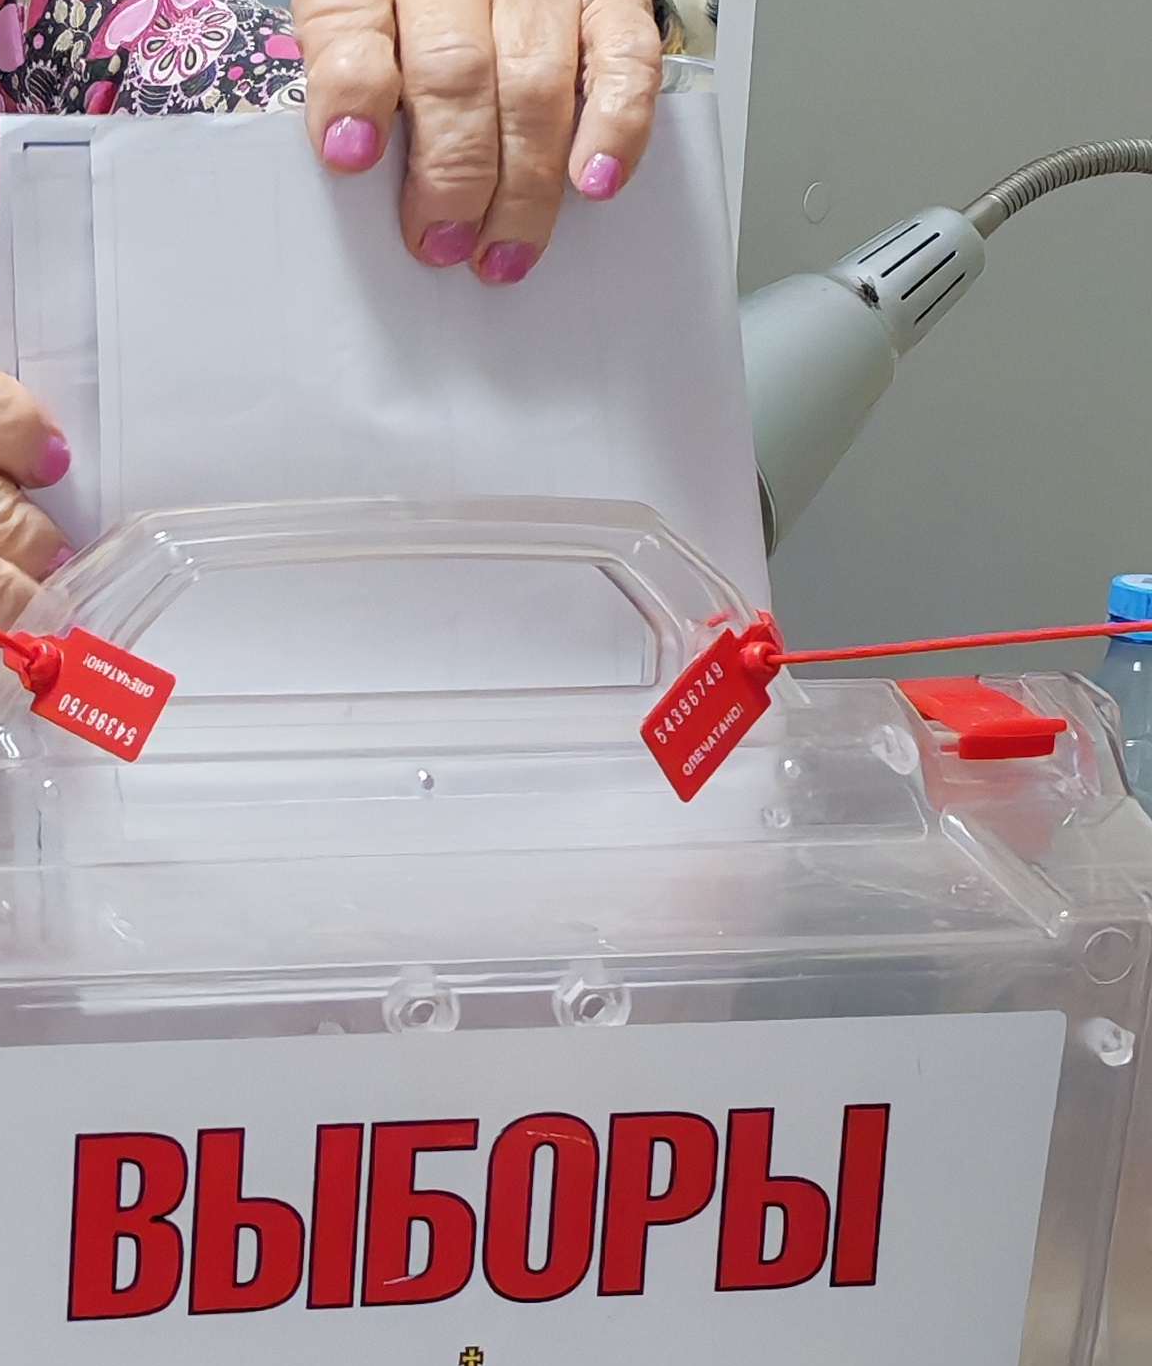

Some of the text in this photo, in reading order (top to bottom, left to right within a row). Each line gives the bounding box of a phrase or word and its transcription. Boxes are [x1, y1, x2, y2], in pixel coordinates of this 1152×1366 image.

[82, 652, 156, 699] ОПЕЧАТАНО!
[653, 661, 725, 744] 54396749
[57, 692, 139, 747] 54396750
[681, 702, 745, 777] ОПЕЧАТАНО!
[67, 1103, 891, 1322] ВЫБОРЫ
